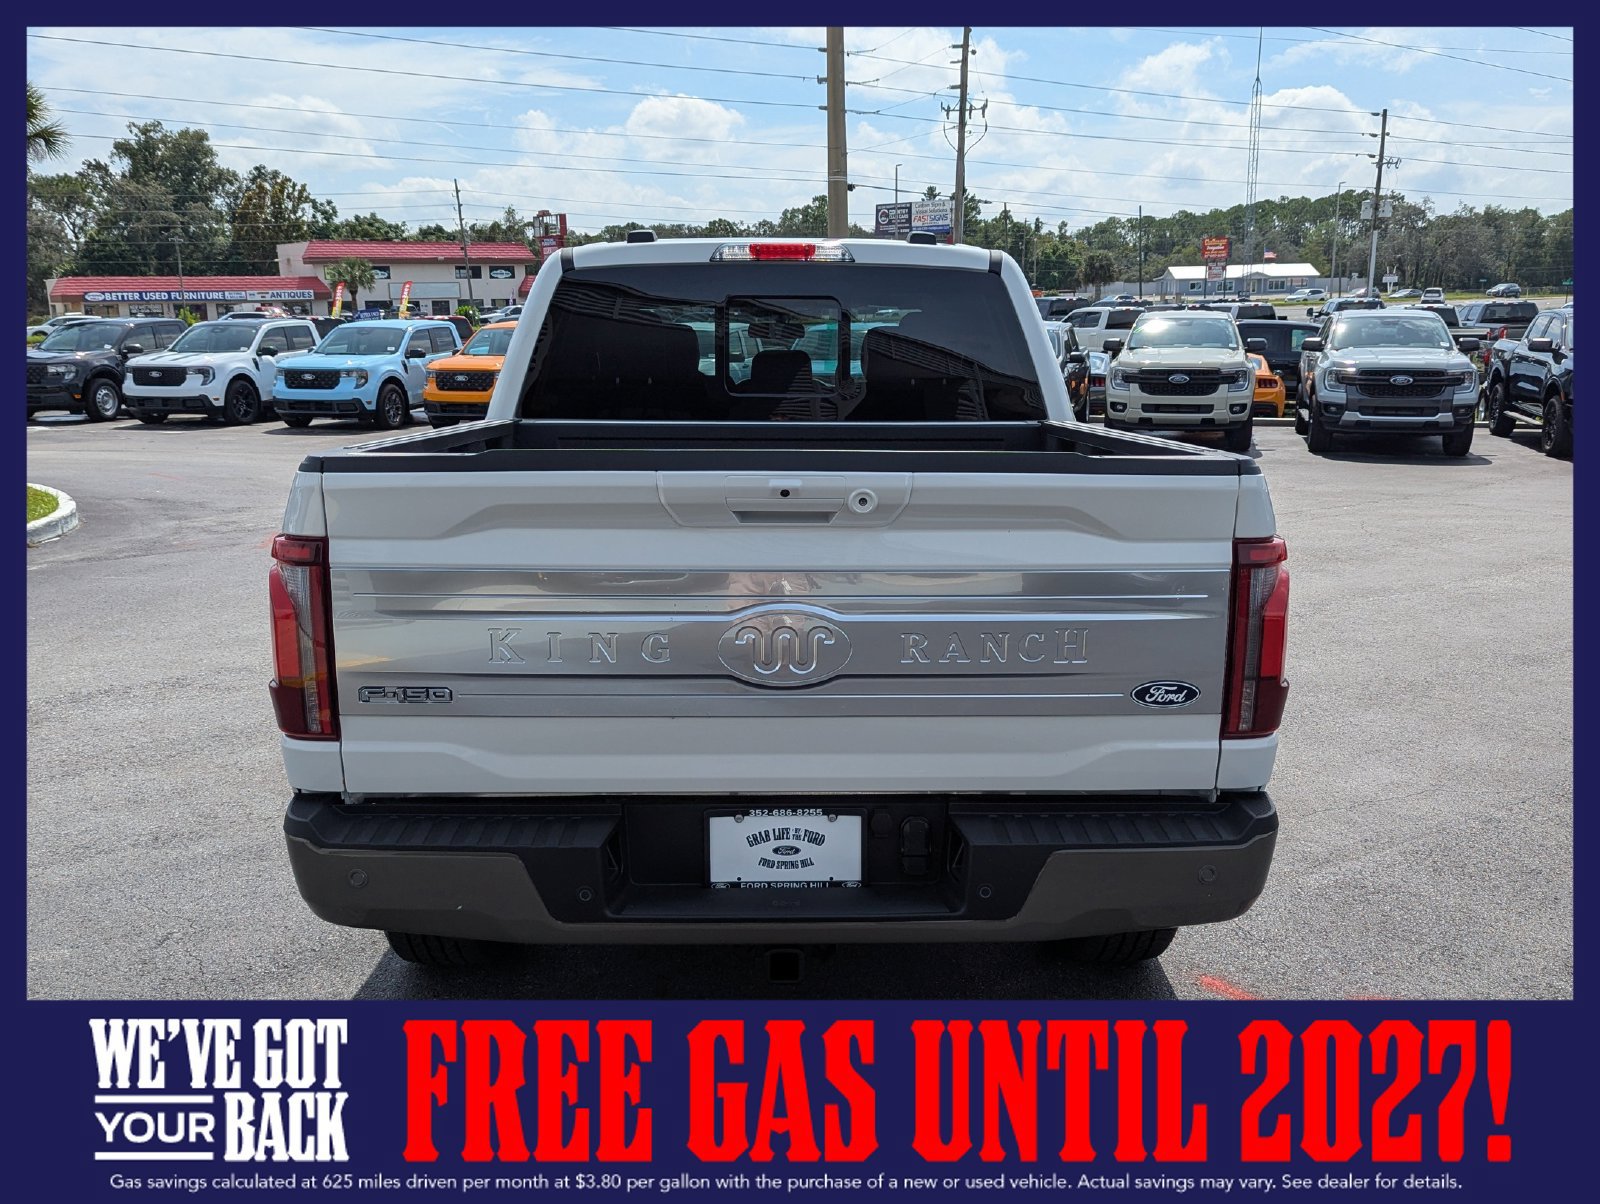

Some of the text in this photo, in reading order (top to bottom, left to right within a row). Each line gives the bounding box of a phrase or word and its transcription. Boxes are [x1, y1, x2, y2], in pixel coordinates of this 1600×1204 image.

[105, 292, 141, 301] BETTER
[142, 292, 169, 300] USED
[170, 291, 225, 300] FURNITURE
[270, 291, 313, 299] ANTIQUES
[487, 627, 1089, 664] KING RANCH
[358, 686, 454, 704] F-150
[1144, 685, 1188, 702] Ford
[748, 808, 823, 817] 352-686-8255
[746, 830, 771, 847] GRAB
[772, 827, 791, 841] LIFE
[802, 828, 826, 847] FORD
[758, 856, 815, 870] FORD SPRING HILL
